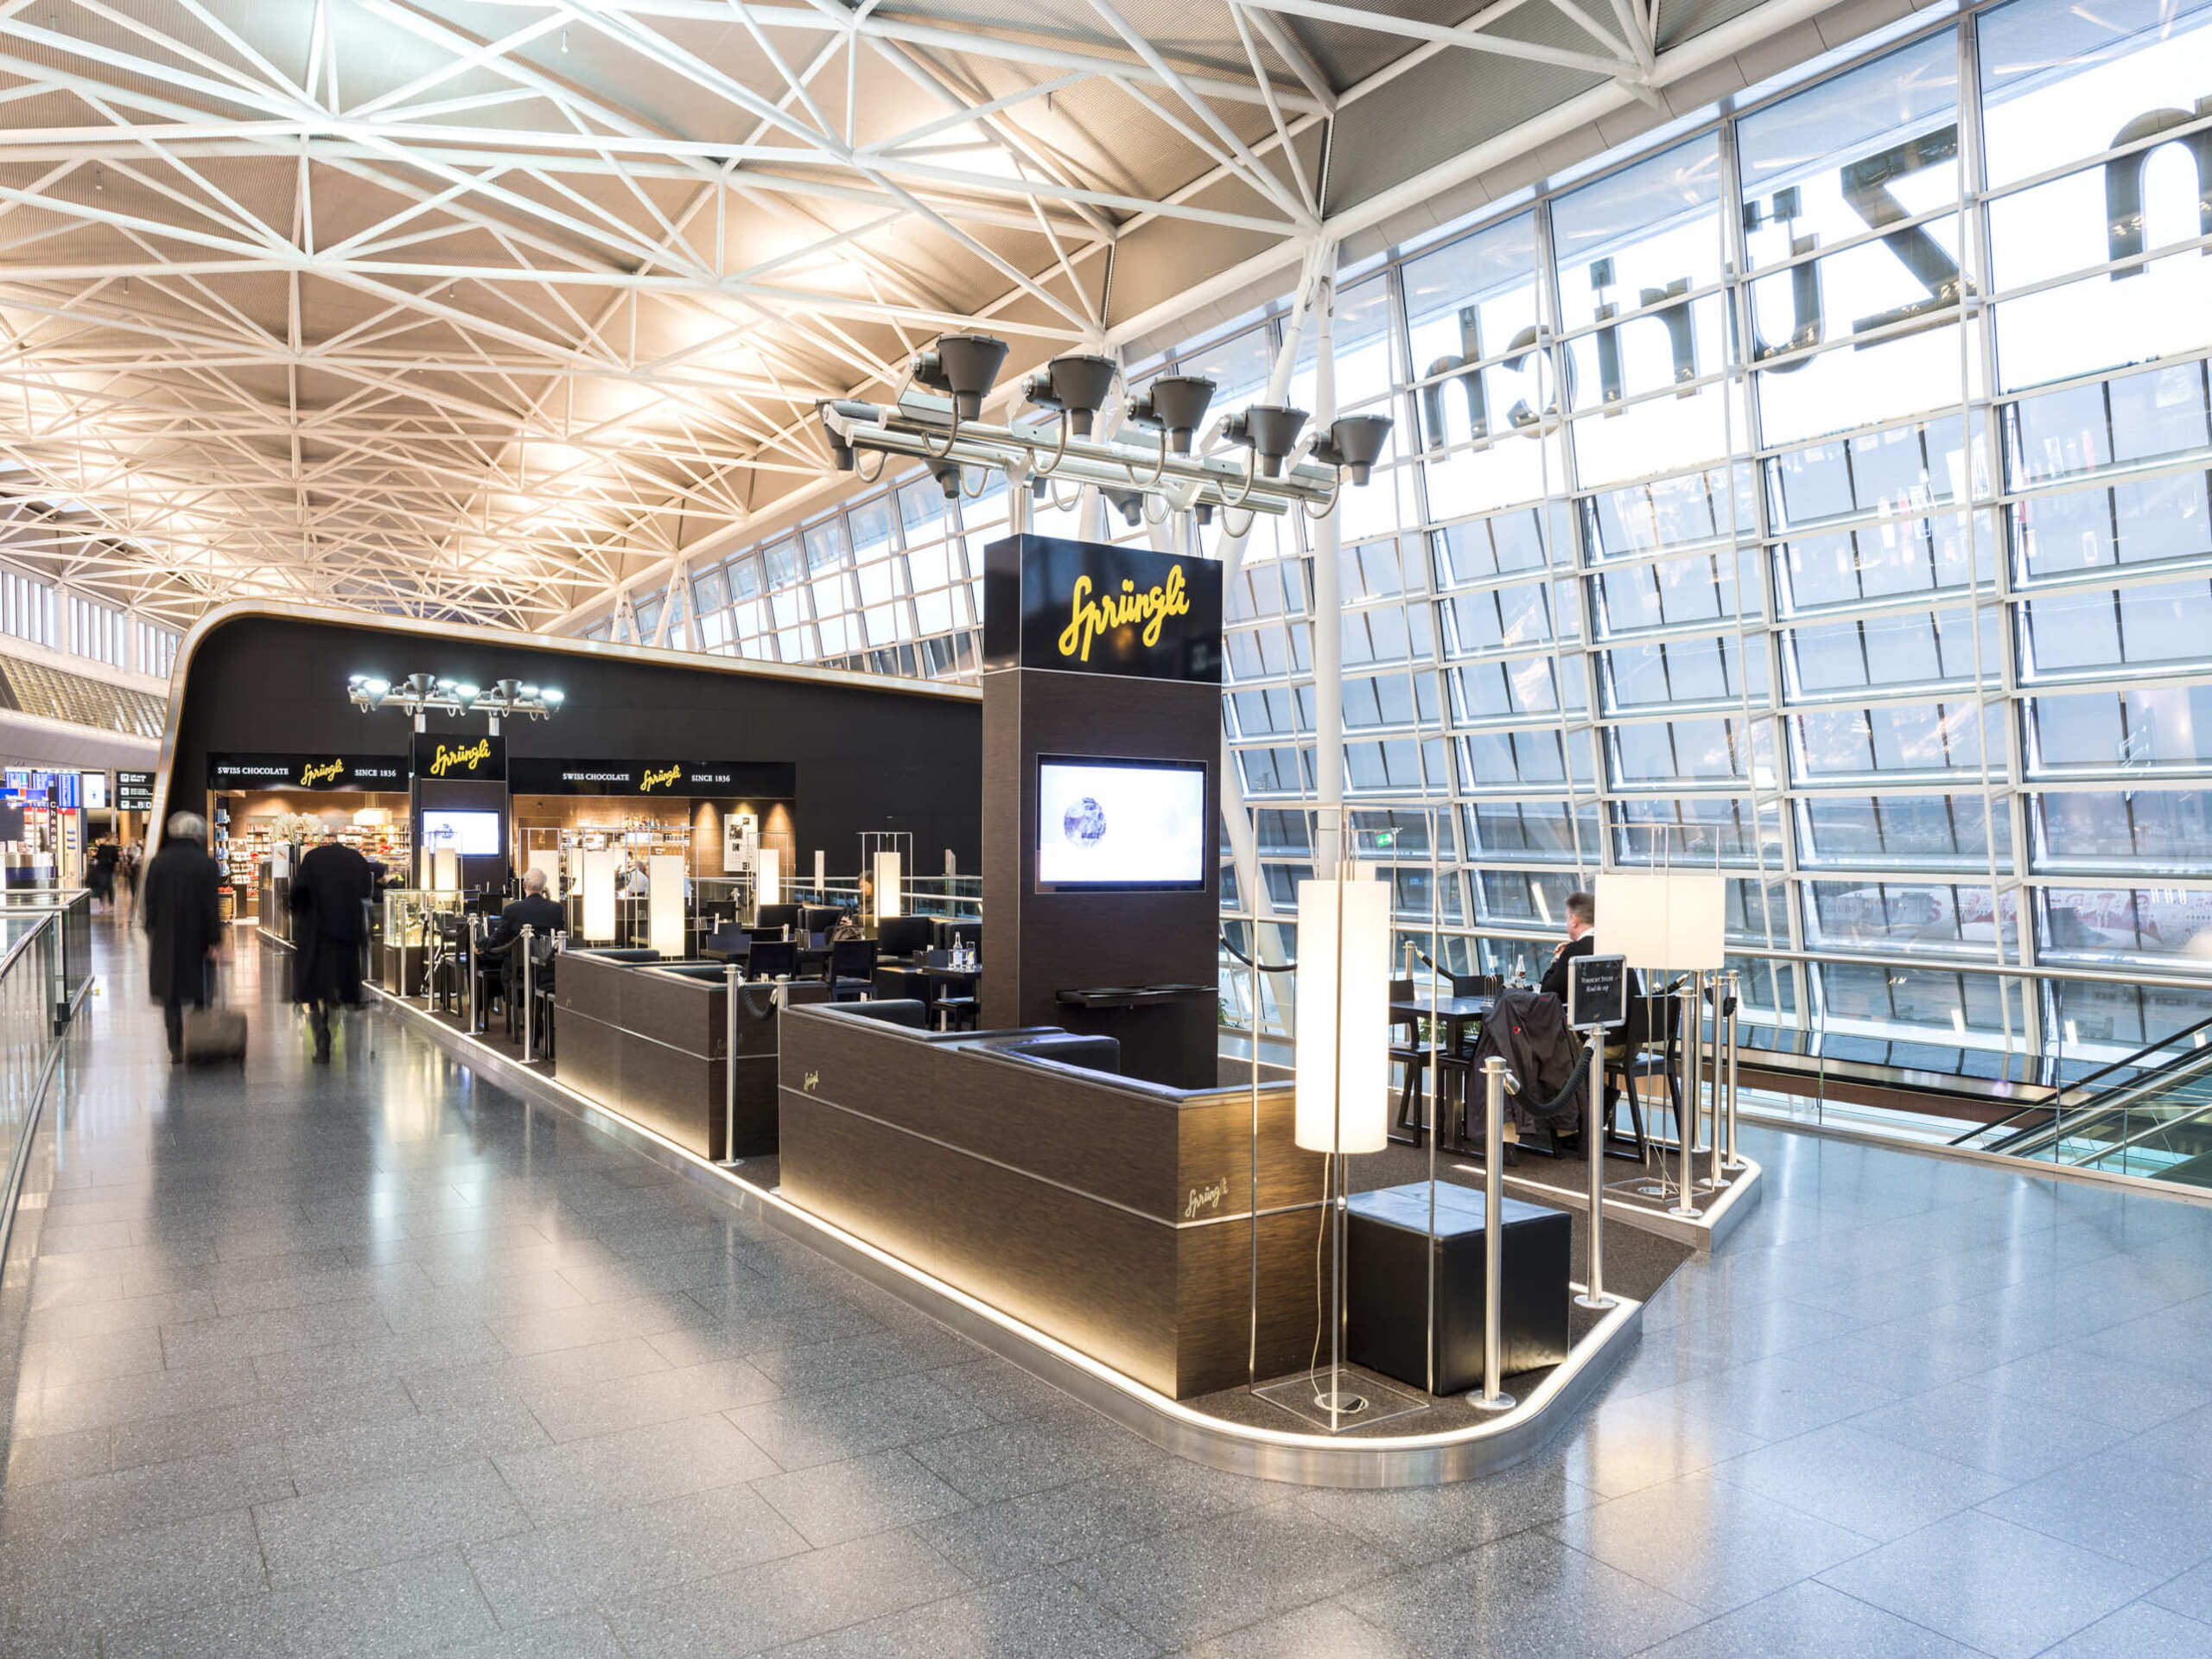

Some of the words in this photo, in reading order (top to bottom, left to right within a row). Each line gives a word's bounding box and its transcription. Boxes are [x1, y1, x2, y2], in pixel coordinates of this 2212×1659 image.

[1058, 564, 1190, 662] Sprüngli
[429, 738, 492, 776] Sprüngli
[218, 766, 240, 775] SWISS
[242, 766, 289, 776] CHOCOLATE
[300, 758, 345, 786] Sprüngli
[354, 768, 378, 778] SINCE
[379, 769, 397, 778] 1836
[563, 772, 584, 781] SWISS
[585, 772, 630, 782] CHOCOLATE
[639, 764, 682, 792] Sprüngli
[691, 774, 713, 783] SINCE
[715, 774, 731, 783] 1836
